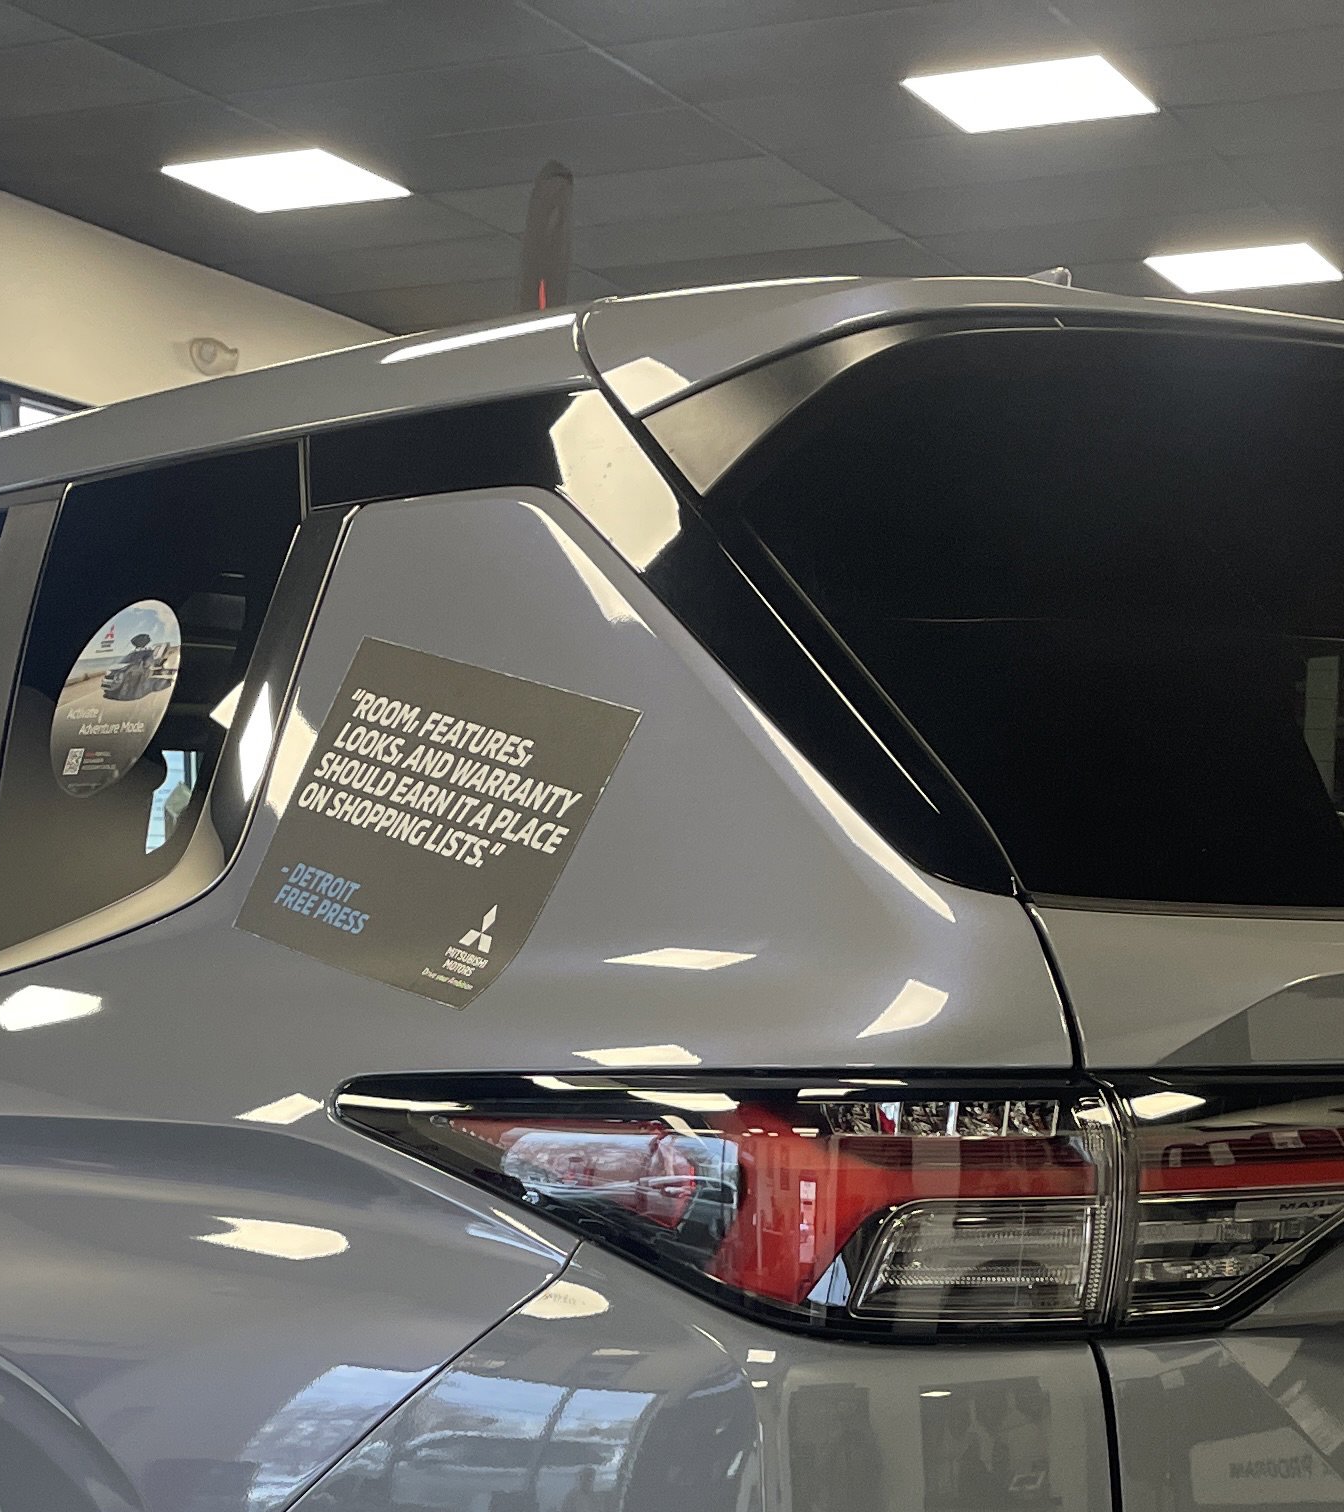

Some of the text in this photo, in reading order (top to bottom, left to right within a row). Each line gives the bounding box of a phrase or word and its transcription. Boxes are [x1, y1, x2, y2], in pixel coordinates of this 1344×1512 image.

[78, 723, 120, 735] Adventure
[418, 711, 534, 768] FEATURES,
[333, 722, 583, 819] LOOKS, AND WARRANTY
[298, 782, 334, 813] ON
[325, 792, 433, 846] SHOPPING
[314, 751, 570, 855] SHOULD EARN IT A PLACE
[288, 863, 361, 903] DETROIT
[273, 884, 370, 934] FREE PRESS
[441, 958, 476, 977] MOTORS
[444, 946, 489, 969] MITSUBISHI
